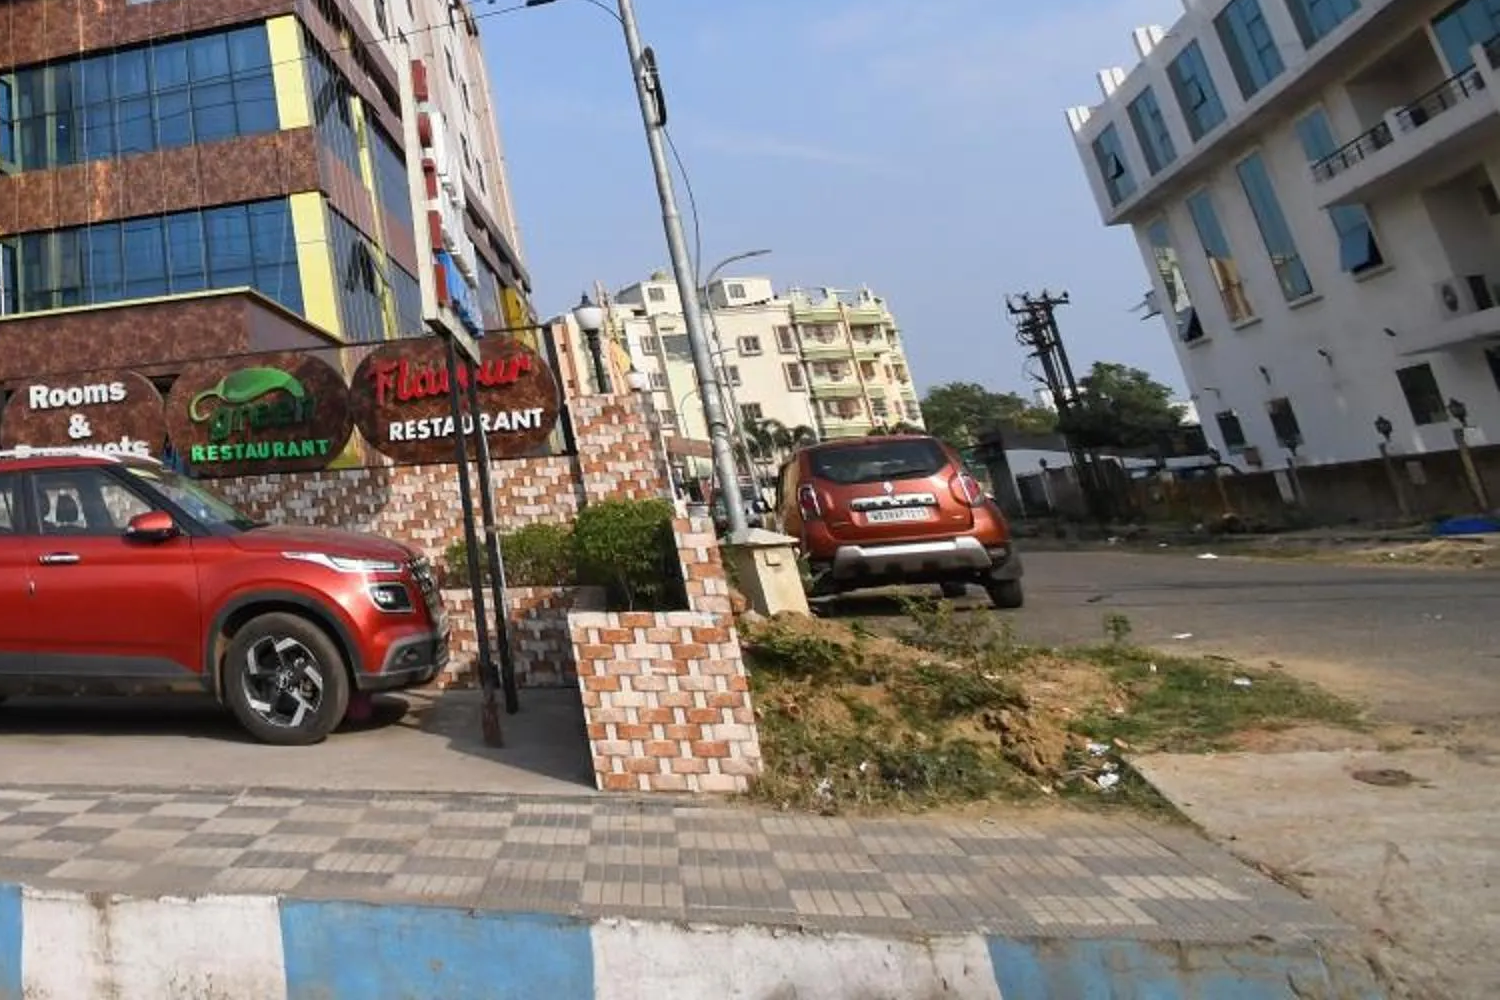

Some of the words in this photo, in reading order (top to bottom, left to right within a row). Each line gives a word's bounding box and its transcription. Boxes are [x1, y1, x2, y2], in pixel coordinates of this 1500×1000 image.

[29, 381, 128, 409] Rooms
[68, 413, 93, 439] &
[389, 407, 544, 441] RESTAURANT
[191, 439, 329, 462] RESTAURANT
